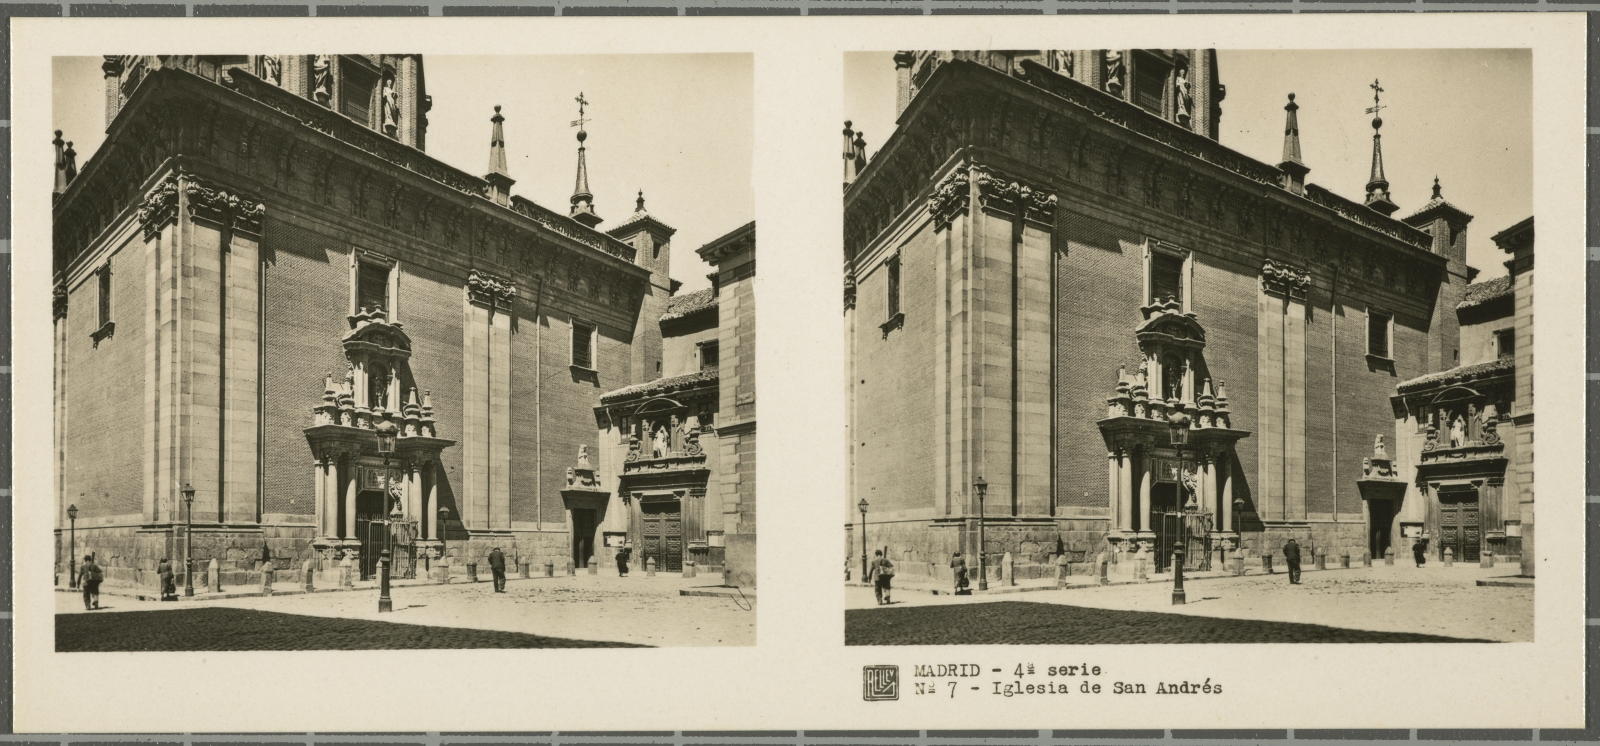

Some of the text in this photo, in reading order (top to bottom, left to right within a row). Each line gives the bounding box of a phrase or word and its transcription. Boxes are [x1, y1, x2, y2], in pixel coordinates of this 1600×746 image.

[914, 663, 981, 678] MADRID
[1047, 662, 1102, 677] serie
[947, 681, 958, 699] 7
[992, 680, 1069, 698] Iglesia
[1080, 680, 1102, 695] de
[1112, 681, 1147, 695] San
[1155, 677, 1223, 695] Andrés
